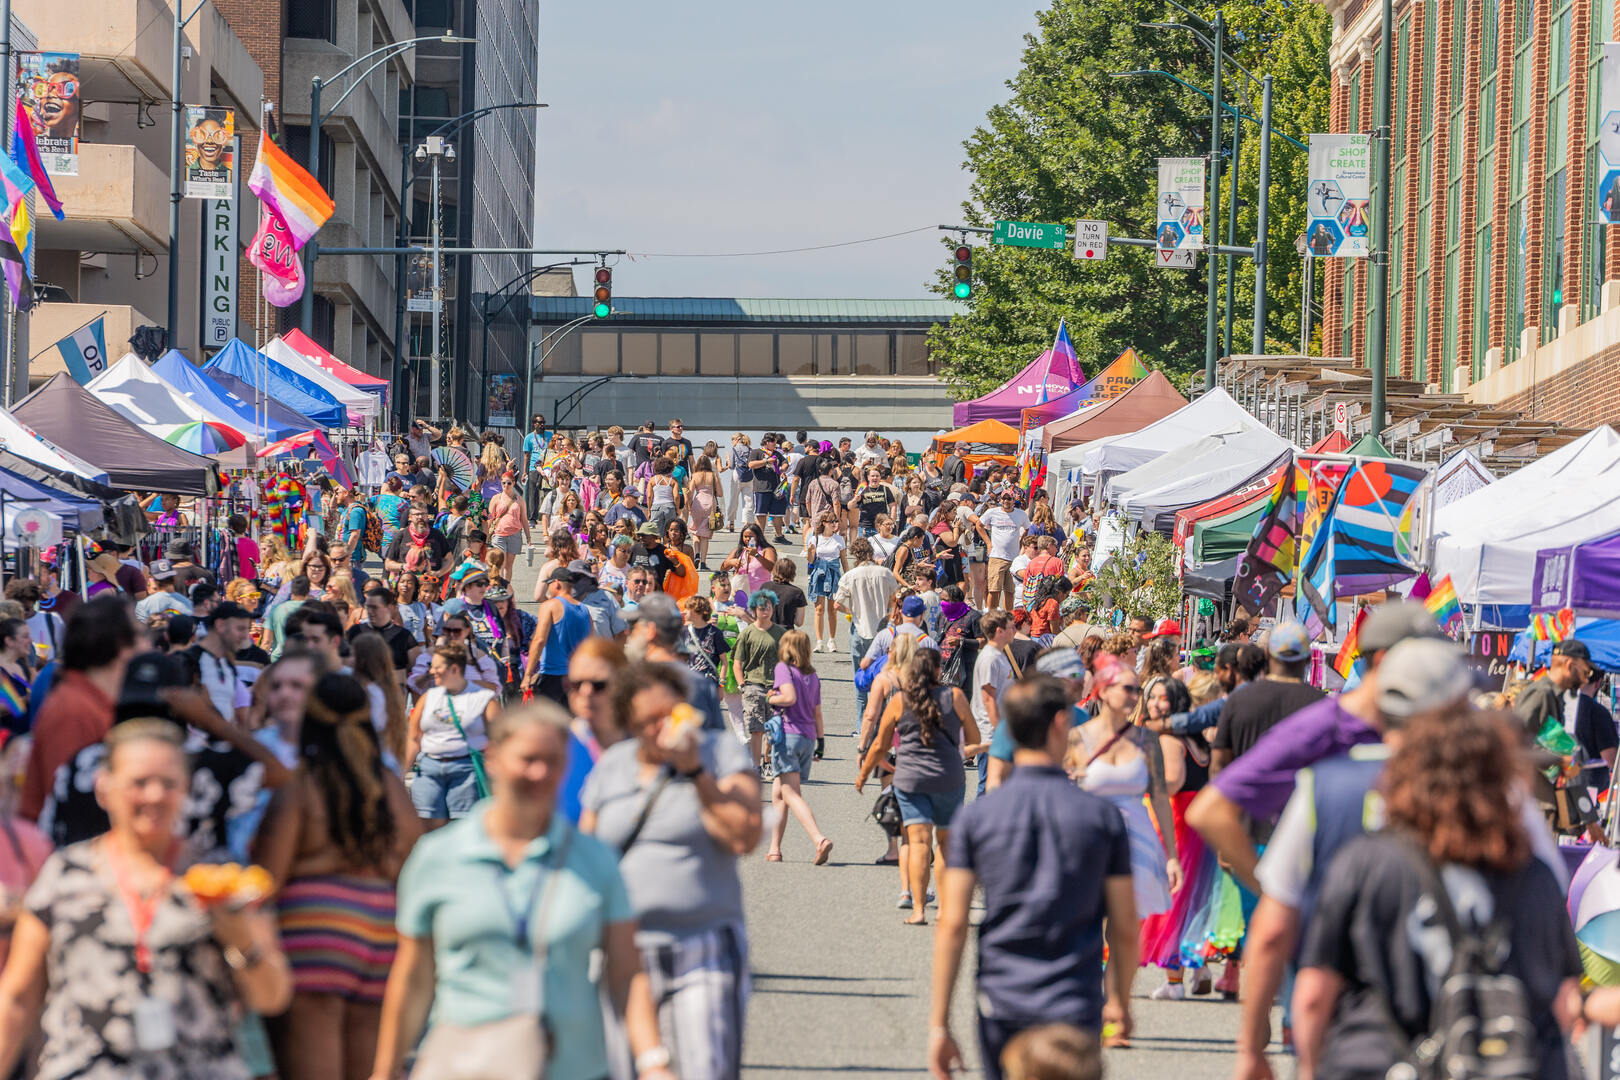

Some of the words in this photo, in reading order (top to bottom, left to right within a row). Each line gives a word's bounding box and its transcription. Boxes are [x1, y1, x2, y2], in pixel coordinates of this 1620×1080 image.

[35, 136, 69, 146] lebrate
[1350, 136, 1366, 144] SEE
[1340, 148, 1366, 156] SHOP
[1329, 159, 1366, 168] CREATE
[199, 169, 219, 177] Taste
[1181, 167, 1202, 175] SHOP
[1173, 176, 1201, 184] CREATE
[996, 222, 1002, 230] N
[1007, 222, 1044, 241] Davie
[1055, 226, 1062, 235] St
[1084, 224, 1099, 232] NO
[1077, 240, 1087, 248] ON
[213, 199, 231, 313] ARKING
[211, 317, 231, 326] PUBLIC
[83, 345, 104, 373] OP
